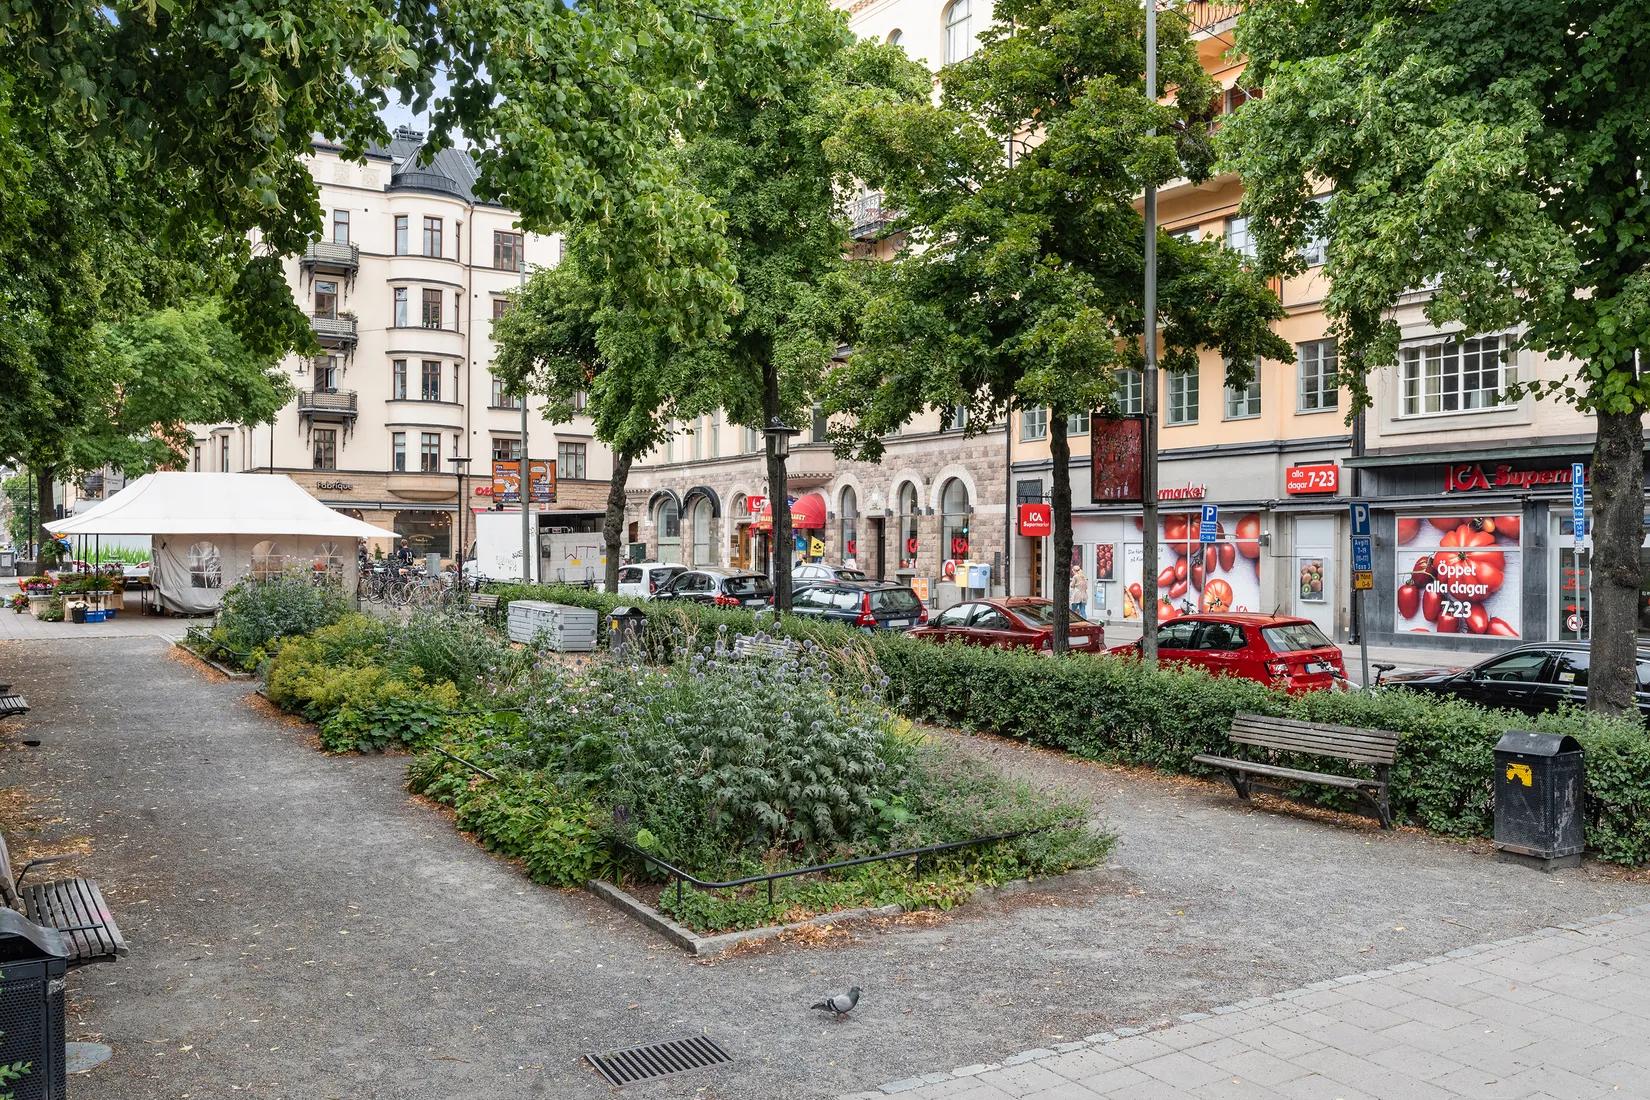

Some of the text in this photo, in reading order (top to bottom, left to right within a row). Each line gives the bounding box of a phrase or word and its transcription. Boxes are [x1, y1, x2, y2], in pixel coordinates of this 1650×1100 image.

[1291, 470, 1304, 478] alla
[1308, 471, 1335, 487] 7-23
[1444, 463, 1491, 491] ICA
[1575, 465, 1582, 484] P
[317, 479, 353, 494] Fabrique
[1287, 481, 1308, 490] dagar
[1029, 512, 1043, 522] ICA
[1206, 507, 1215, 521] P
[1354, 505, 1367, 533] P
[1437, 560, 1477, 578] Öppet
[1425, 580, 1489, 597] alla dagar
[1440, 600, 1472, 618] 7-23
